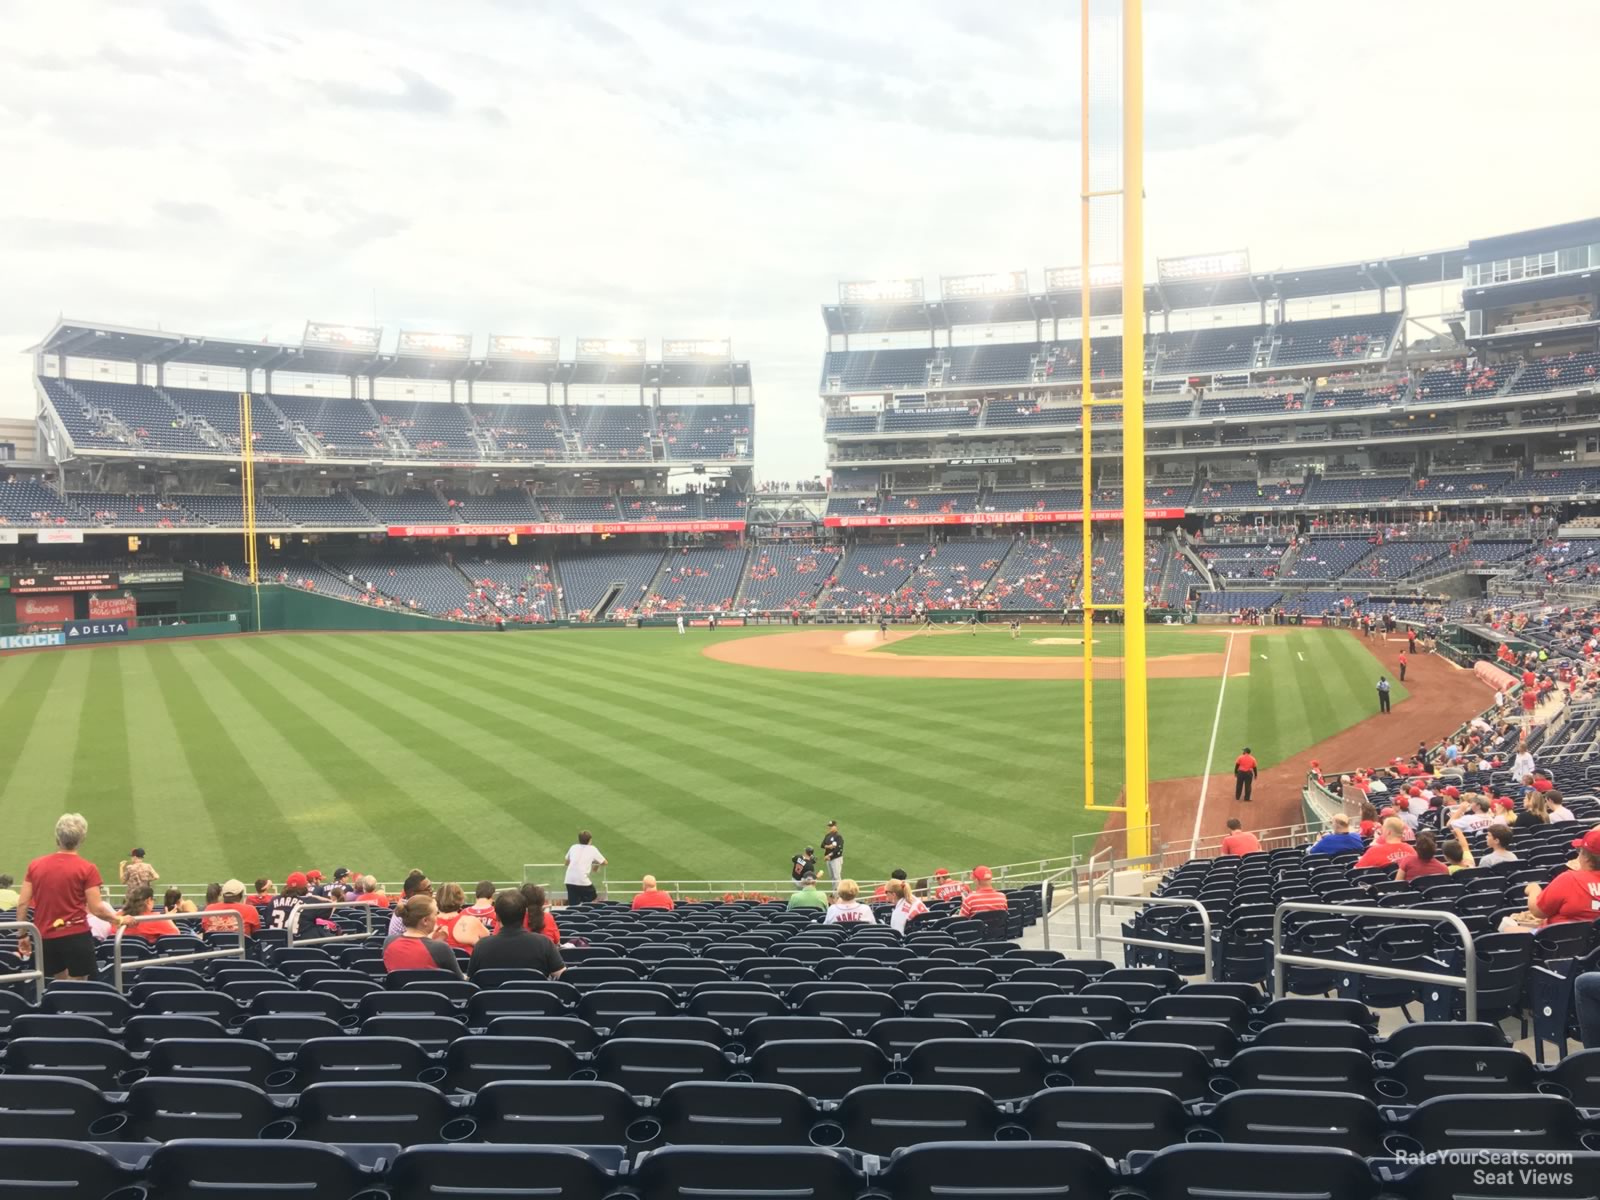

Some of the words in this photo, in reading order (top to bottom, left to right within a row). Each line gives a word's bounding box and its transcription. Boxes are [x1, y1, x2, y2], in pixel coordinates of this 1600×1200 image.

[1544, 504, 1564, 513] PNC
[897, 516, 945, 525] POSTSEASON
[973, 514, 985, 523] ALL
[986, 514, 1004, 522] STAR
[1005, 513, 1024, 522] GAME
[1223, 514, 1241, 522] PNC
[464, 526, 516, 535] POSTSEASON
[543, 524, 556, 534] ALL
[556, 524, 575, 533] STAR
[575, 523, 593, 533] GAME
[19, 578, 36, 586] 6:43
[83, 624, 124, 635] DELTA
[9, 634, 58, 648] KOCH
